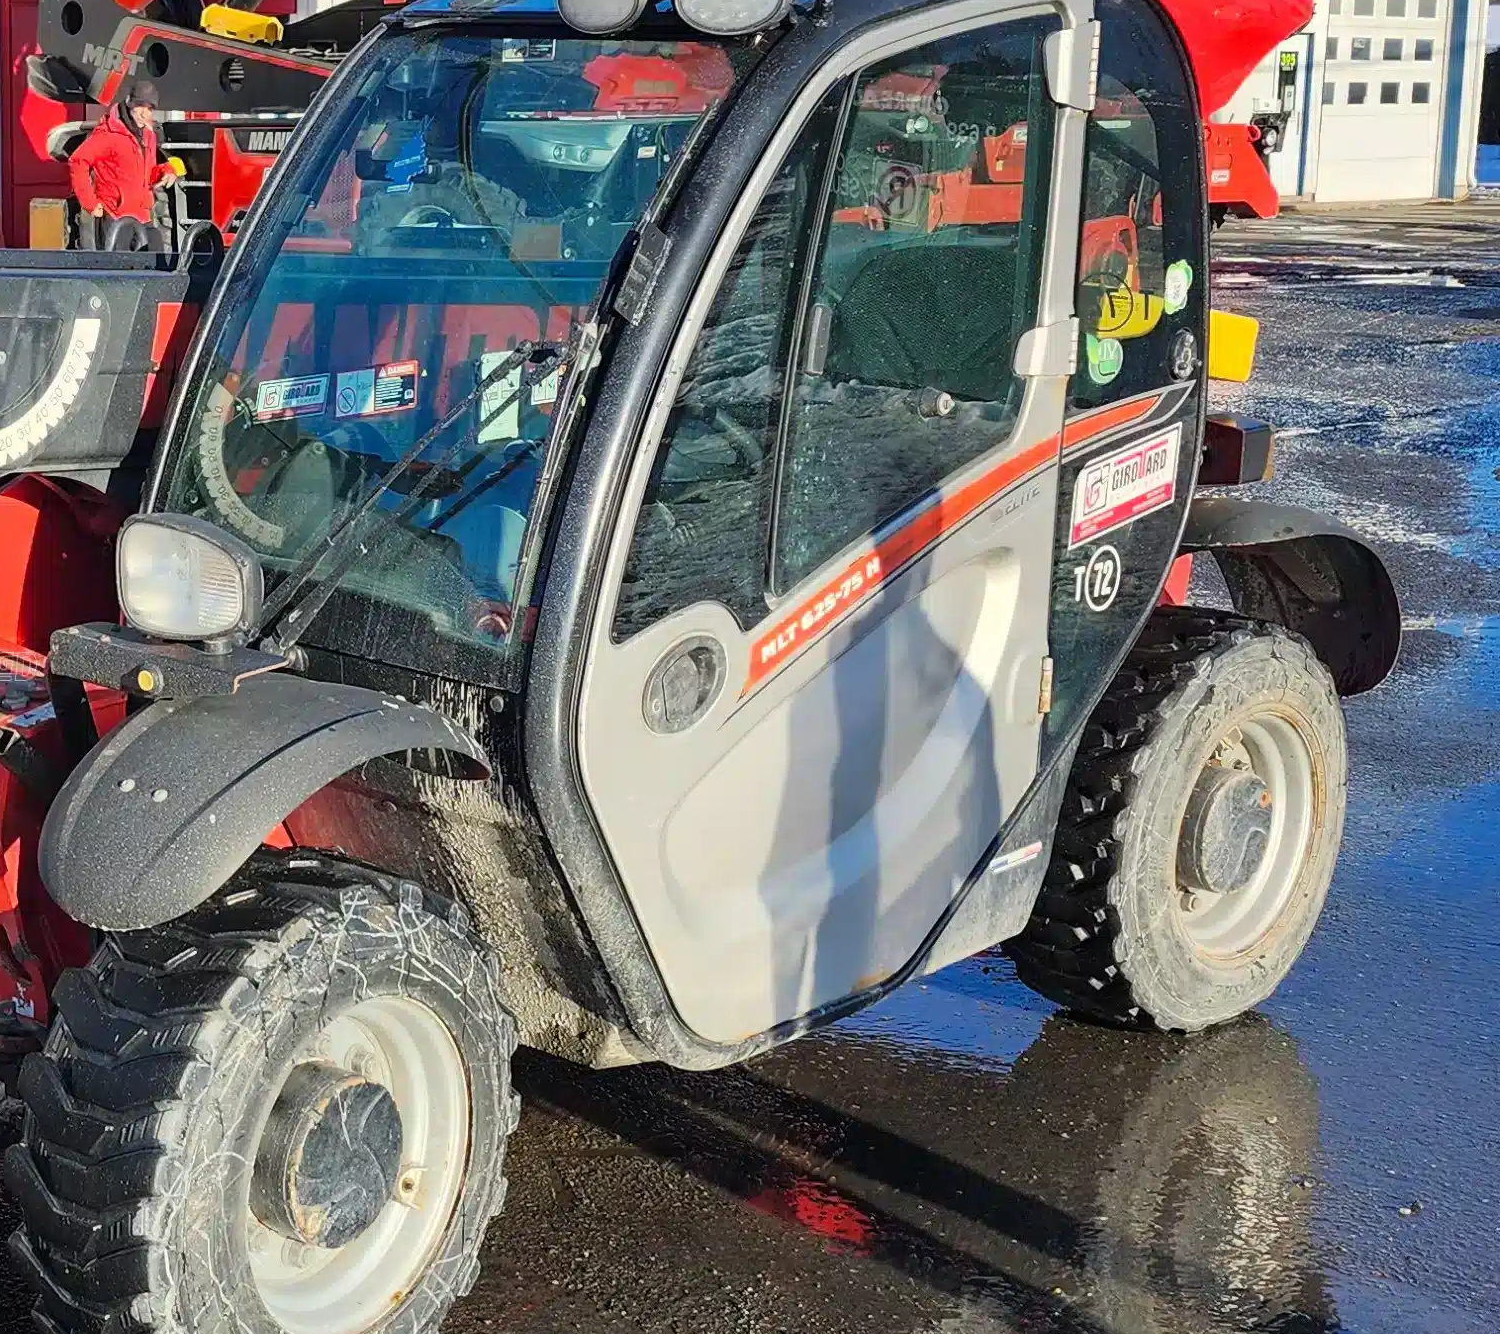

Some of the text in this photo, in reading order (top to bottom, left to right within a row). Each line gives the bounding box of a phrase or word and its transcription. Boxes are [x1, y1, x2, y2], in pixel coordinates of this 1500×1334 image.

[81, 42, 145, 76] MRT
[760, 556, 881, 664] MLT 625-75 H
